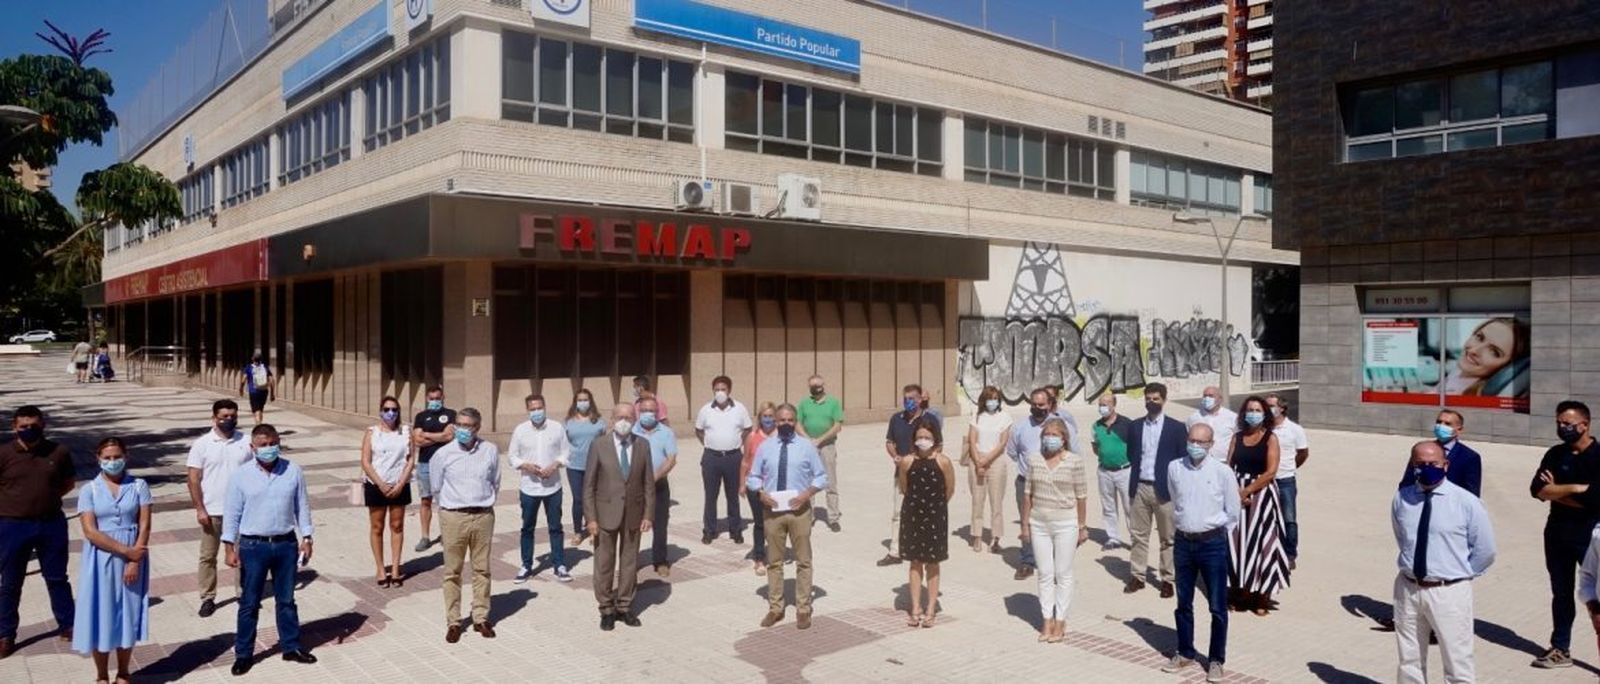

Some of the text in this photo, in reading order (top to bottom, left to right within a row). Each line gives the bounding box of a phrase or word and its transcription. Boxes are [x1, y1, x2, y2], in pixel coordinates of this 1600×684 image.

[757, 27, 841, 58] Partido Popular
[518, 212, 753, 261] FREMAP
